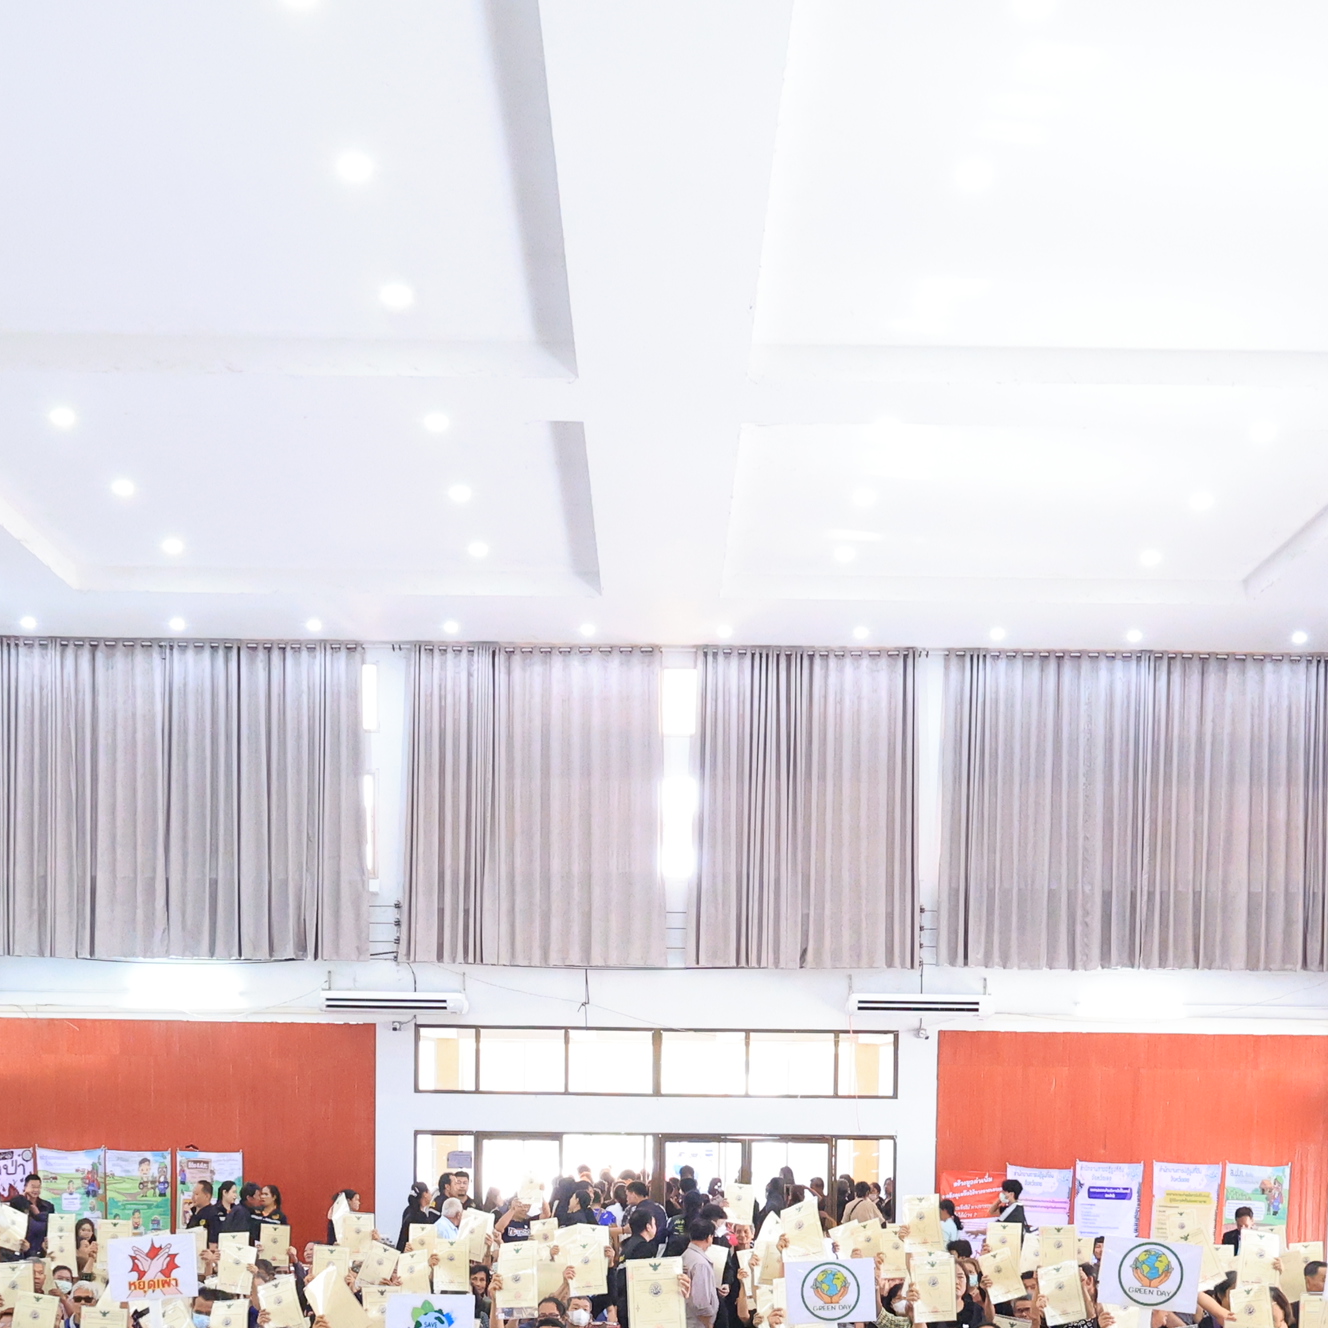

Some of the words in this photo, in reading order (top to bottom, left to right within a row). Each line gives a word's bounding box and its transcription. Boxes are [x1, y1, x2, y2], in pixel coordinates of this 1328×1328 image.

[128, 1278, 178, 1294] หยุดเผา
[1128, 1287, 1154, 1295] GREEN
